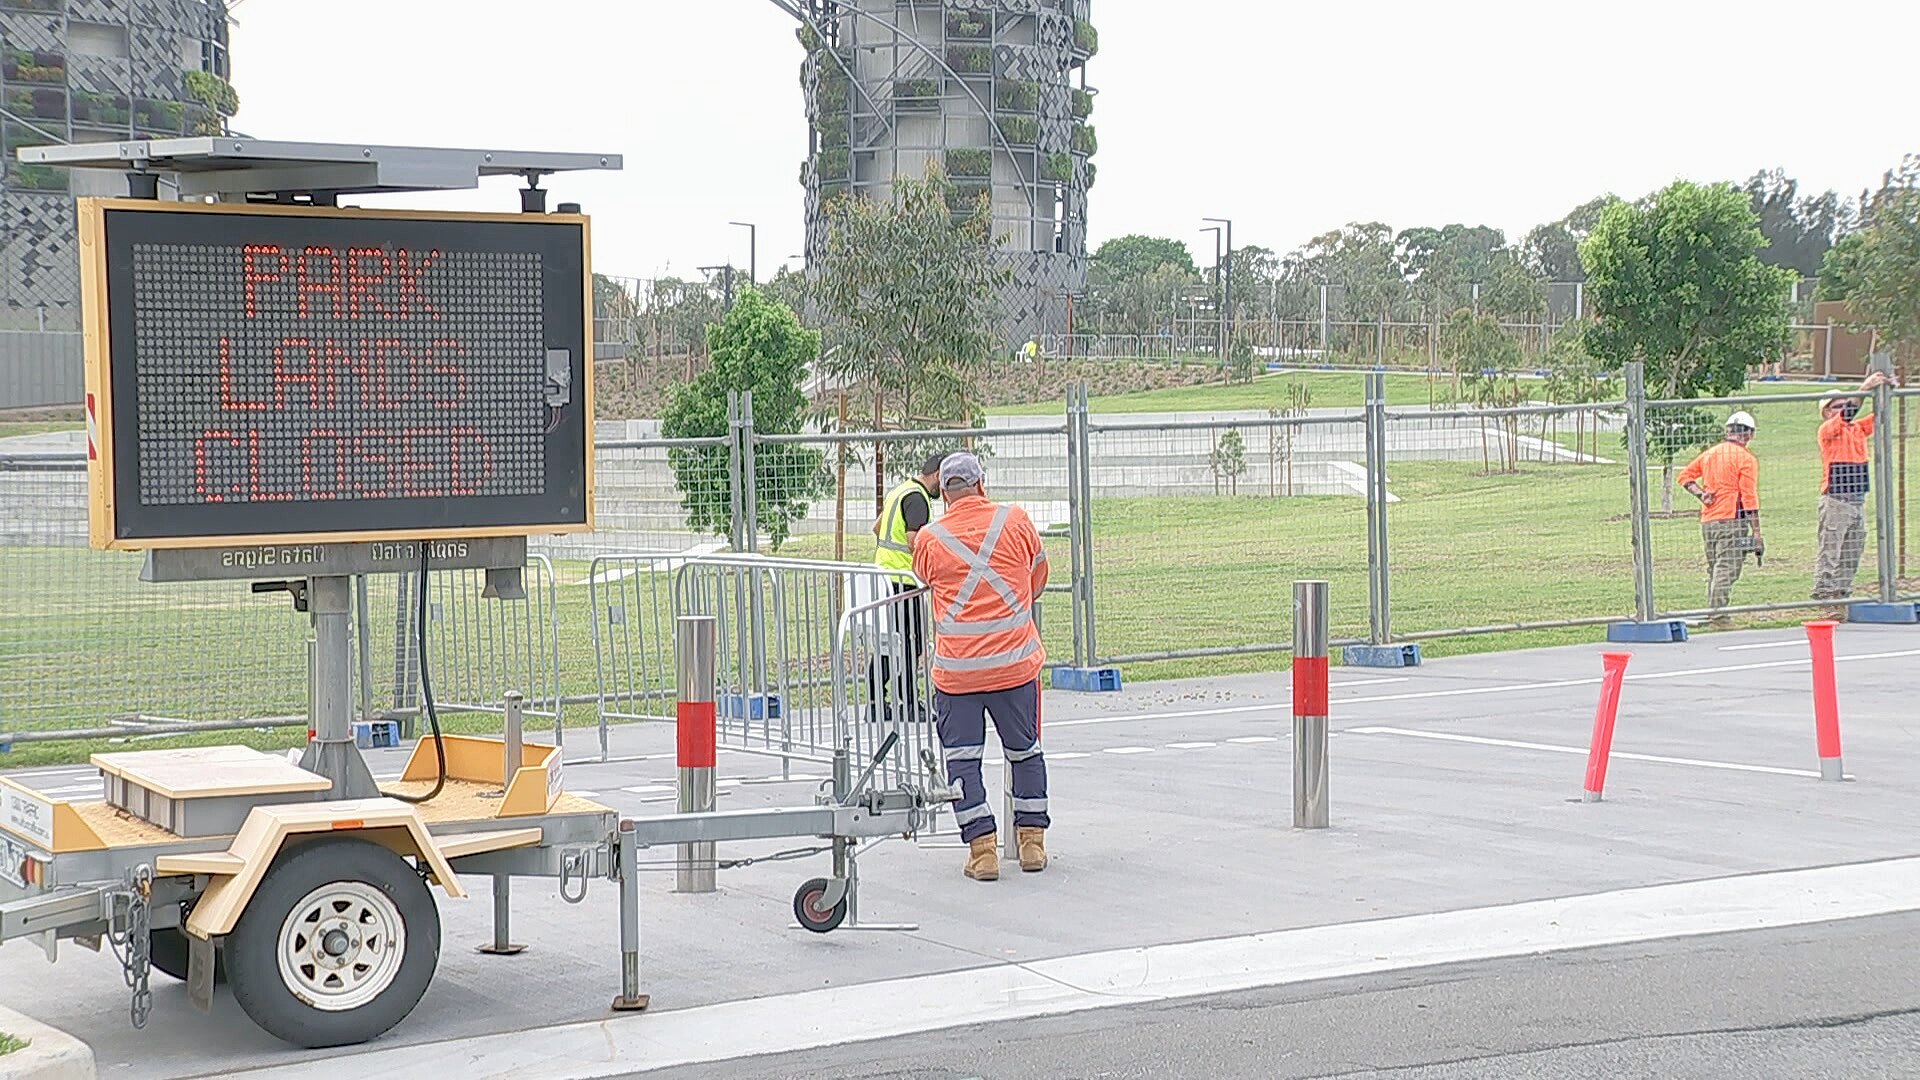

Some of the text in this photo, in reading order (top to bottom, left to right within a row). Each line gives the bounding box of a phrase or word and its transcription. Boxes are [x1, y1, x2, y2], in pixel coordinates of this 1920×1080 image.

[243, 244, 441, 320] PARK
[218, 337, 466, 411] LANDS
[195, 426, 493, 502] CLOSED
[372, 542, 414, 560] Data
